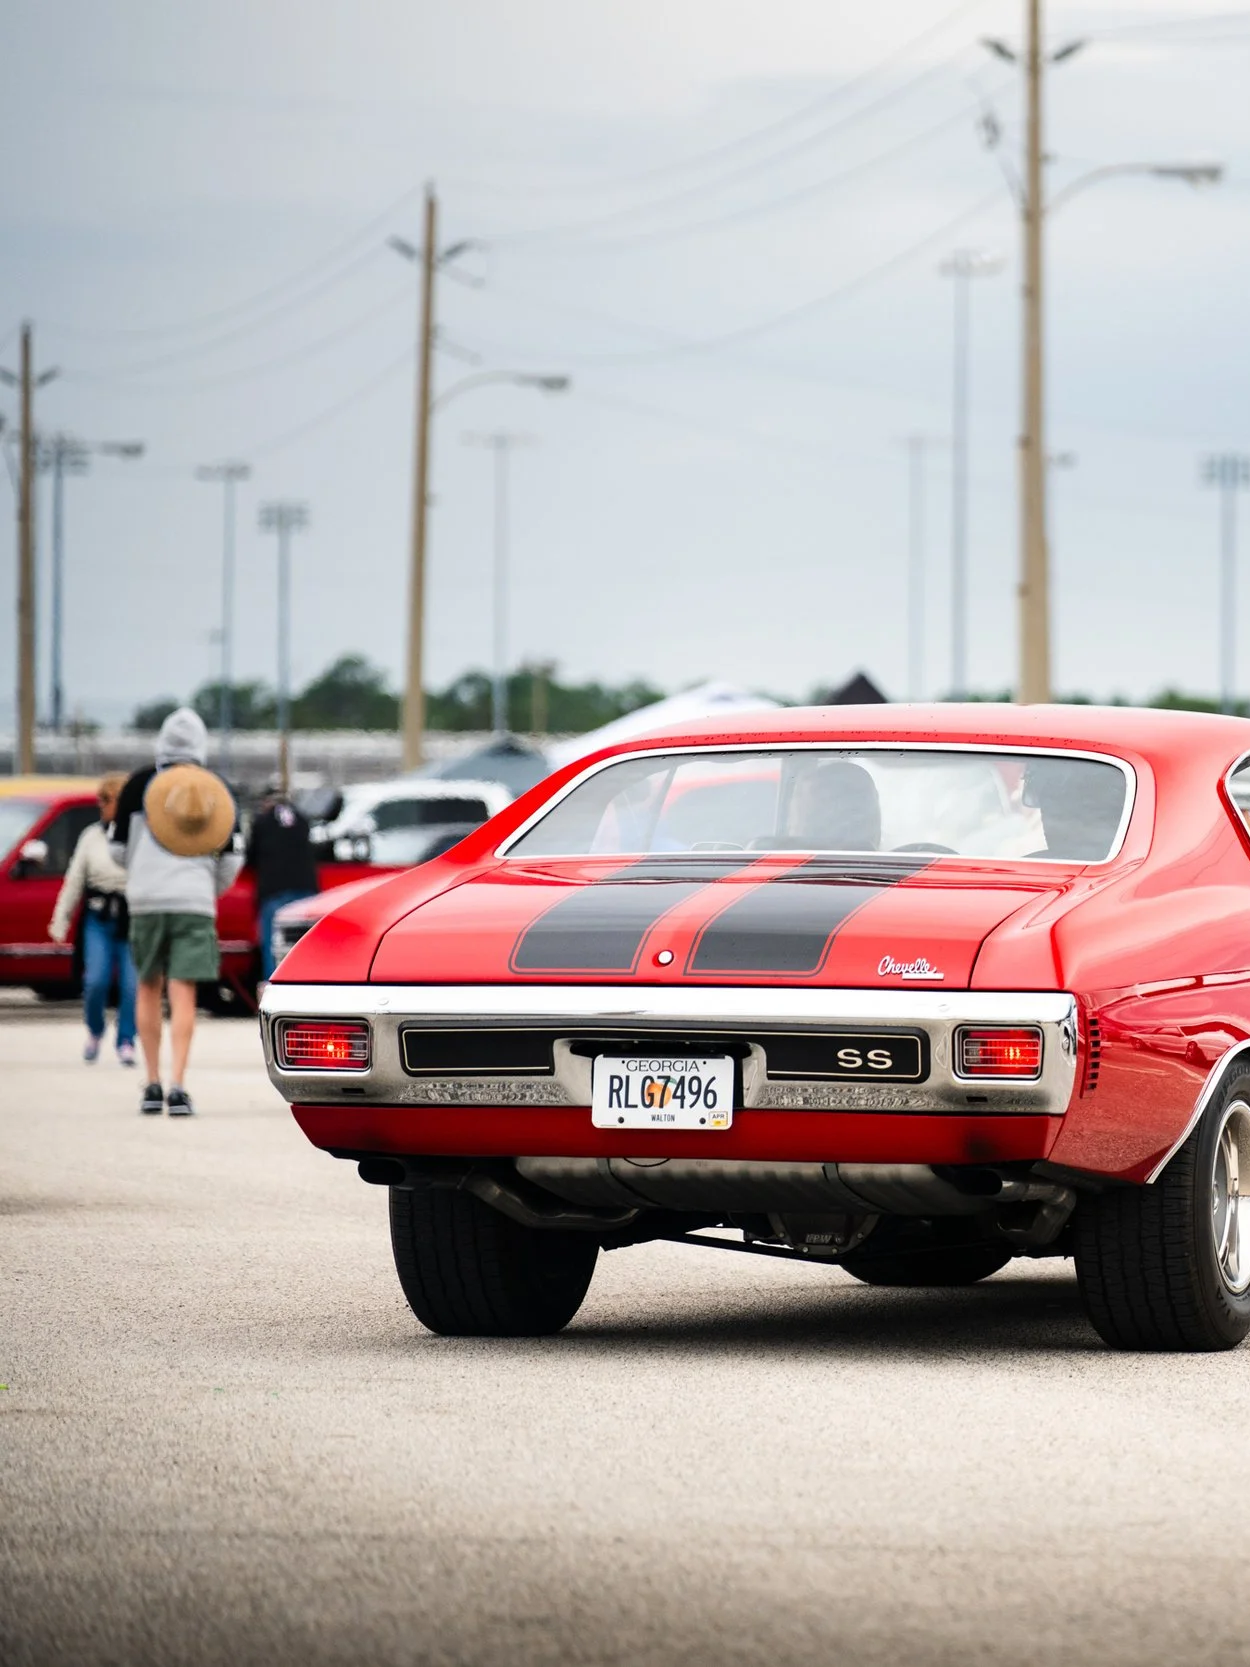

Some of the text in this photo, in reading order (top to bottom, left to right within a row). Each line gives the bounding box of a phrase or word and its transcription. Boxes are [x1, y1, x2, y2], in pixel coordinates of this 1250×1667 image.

[877, 955, 937, 976] Chevelle
[626, 1060, 700, 1072] GEORGIA
[837, 1048, 893, 1069] SS
[608, 1075, 718, 1109] RLG7496
[651, 1114, 675, 1122] WALTON
